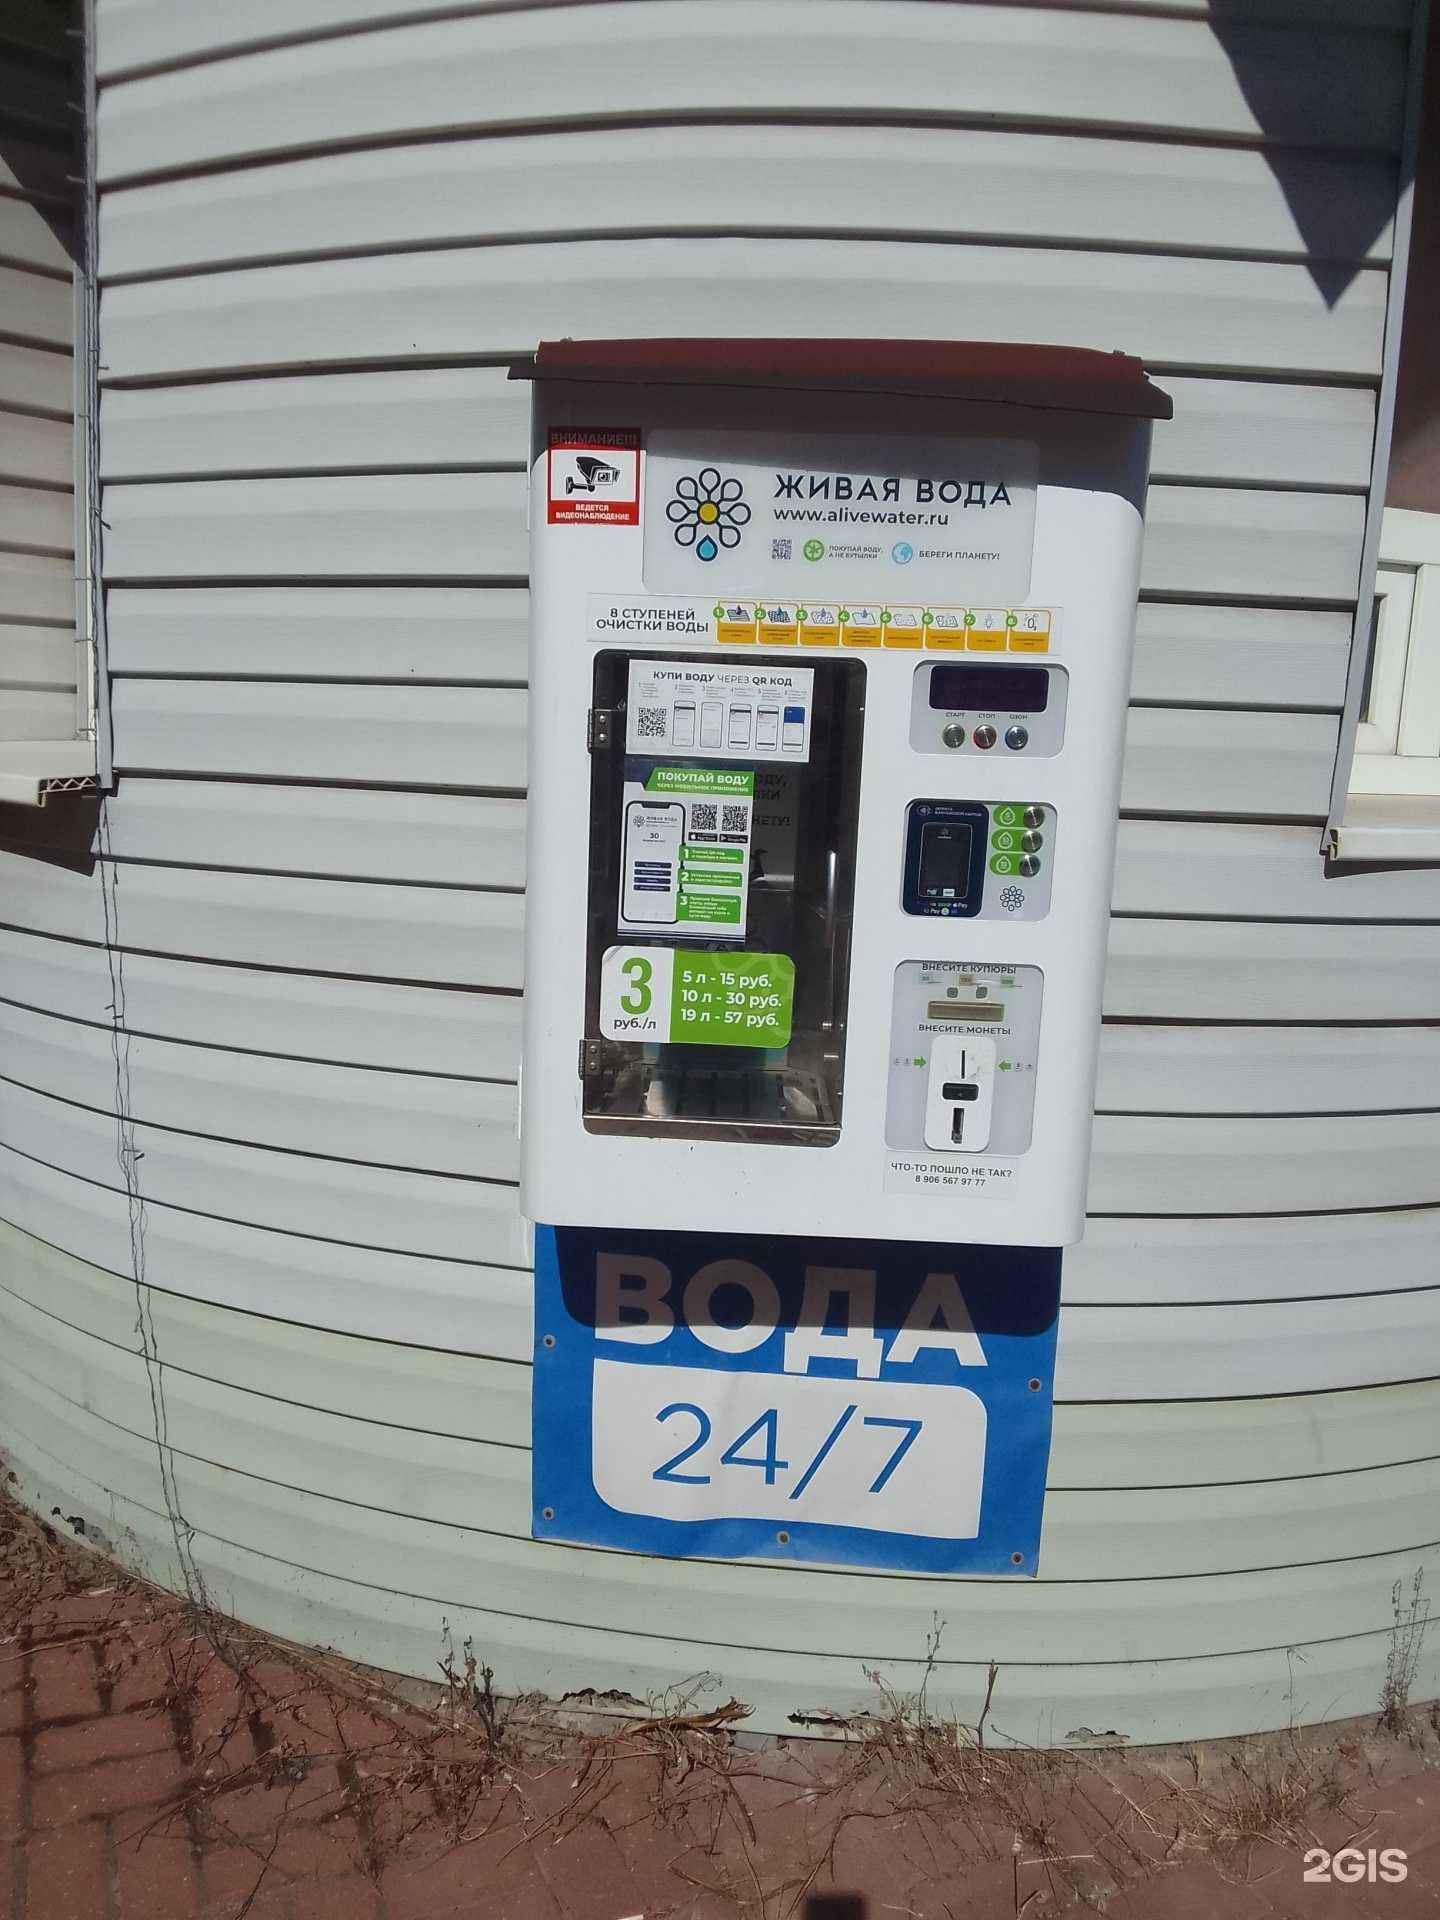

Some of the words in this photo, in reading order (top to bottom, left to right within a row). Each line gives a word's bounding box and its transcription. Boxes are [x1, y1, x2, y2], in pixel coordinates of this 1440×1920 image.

[773, 474, 900, 502] ЖИВАЯ
[915, 478, 1012, 509] ВОДА
[575, 503, 609, 512] ВЕДЕТСЯ
[555, 511, 630, 520] ВИДЕОНАБЛЮДЕНИЕ
[773, 507, 949, 526] www.alivewater.ru
[828, 545, 862, 553] ПОКУПАЙ
[918, 550, 953, 559] БЕРЕГИ
[954, 551, 1000, 560] ПЛАНЕТУ!
[610, 608, 618, 618] 8
[622, 608, 695, 621] СТУПЕНЕЙ
[596, 619, 663, 631] ОЧИСТКИ
[666, 621, 709, 633] ВОДЫ
[653, 671, 682, 681] КУПИ
[685, 672, 715, 683] ВОДУ
[717, 674, 750, 684] ЧЕРЕЗ
[752, 676, 767, 686] QR
[770, 677, 793, 688] КОД
[657, 771, 715, 784] ПОКУПАЙ
[717, 774, 750, 786] ВОДУ
[681, 872, 689, 881] 2
[680, 896, 688, 905] 3
[921, 963, 967, 973] ВНЕСИТЕ
[970, 965, 1016, 975] КУПЮРЫ
[620, 957, 652, 1015] 3
[682, 971, 692, 983] 5
[695, 974, 706, 984] л
[720, 973, 735, 984] 15
[739, 975, 773, 989] руб.
[682, 990, 698, 1002] 10
[702, 993, 712, 1003] л
[726, 992, 745, 1005] 30
[749, 995, 782, 1008] руб.
[613, 1017, 657, 1030] руб./л
[681, 1009, 696, 1021] 19
[700, 1012, 710, 1022] л
[724, 1011, 743, 1023] 57
[746, 1013, 779, 1027] руб.
[918, 1024, 964, 1033] ВНЕСИТЕ
[967, 1025, 1011, 1035] МОНЕТЫ
[891, 1162, 927, 1172] ЧТО-ТО
[930, 1164, 968, 1175] ПОШЛО
[971, 1167, 985, 1176] НЕ
[988, 1168, 1012, 1177] ТАК?
[915, 1175, 921, 1183] 8
[923, 1175, 940, 1184] 906
[942, 1176, 959, 1185] 567
[961, 1177, 973, 1186] 97
[975, 1178, 986, 1186] 77
[595, 1251, 989, 1379] ВОДА
[652, 1402, 924, 1500] 24/7
